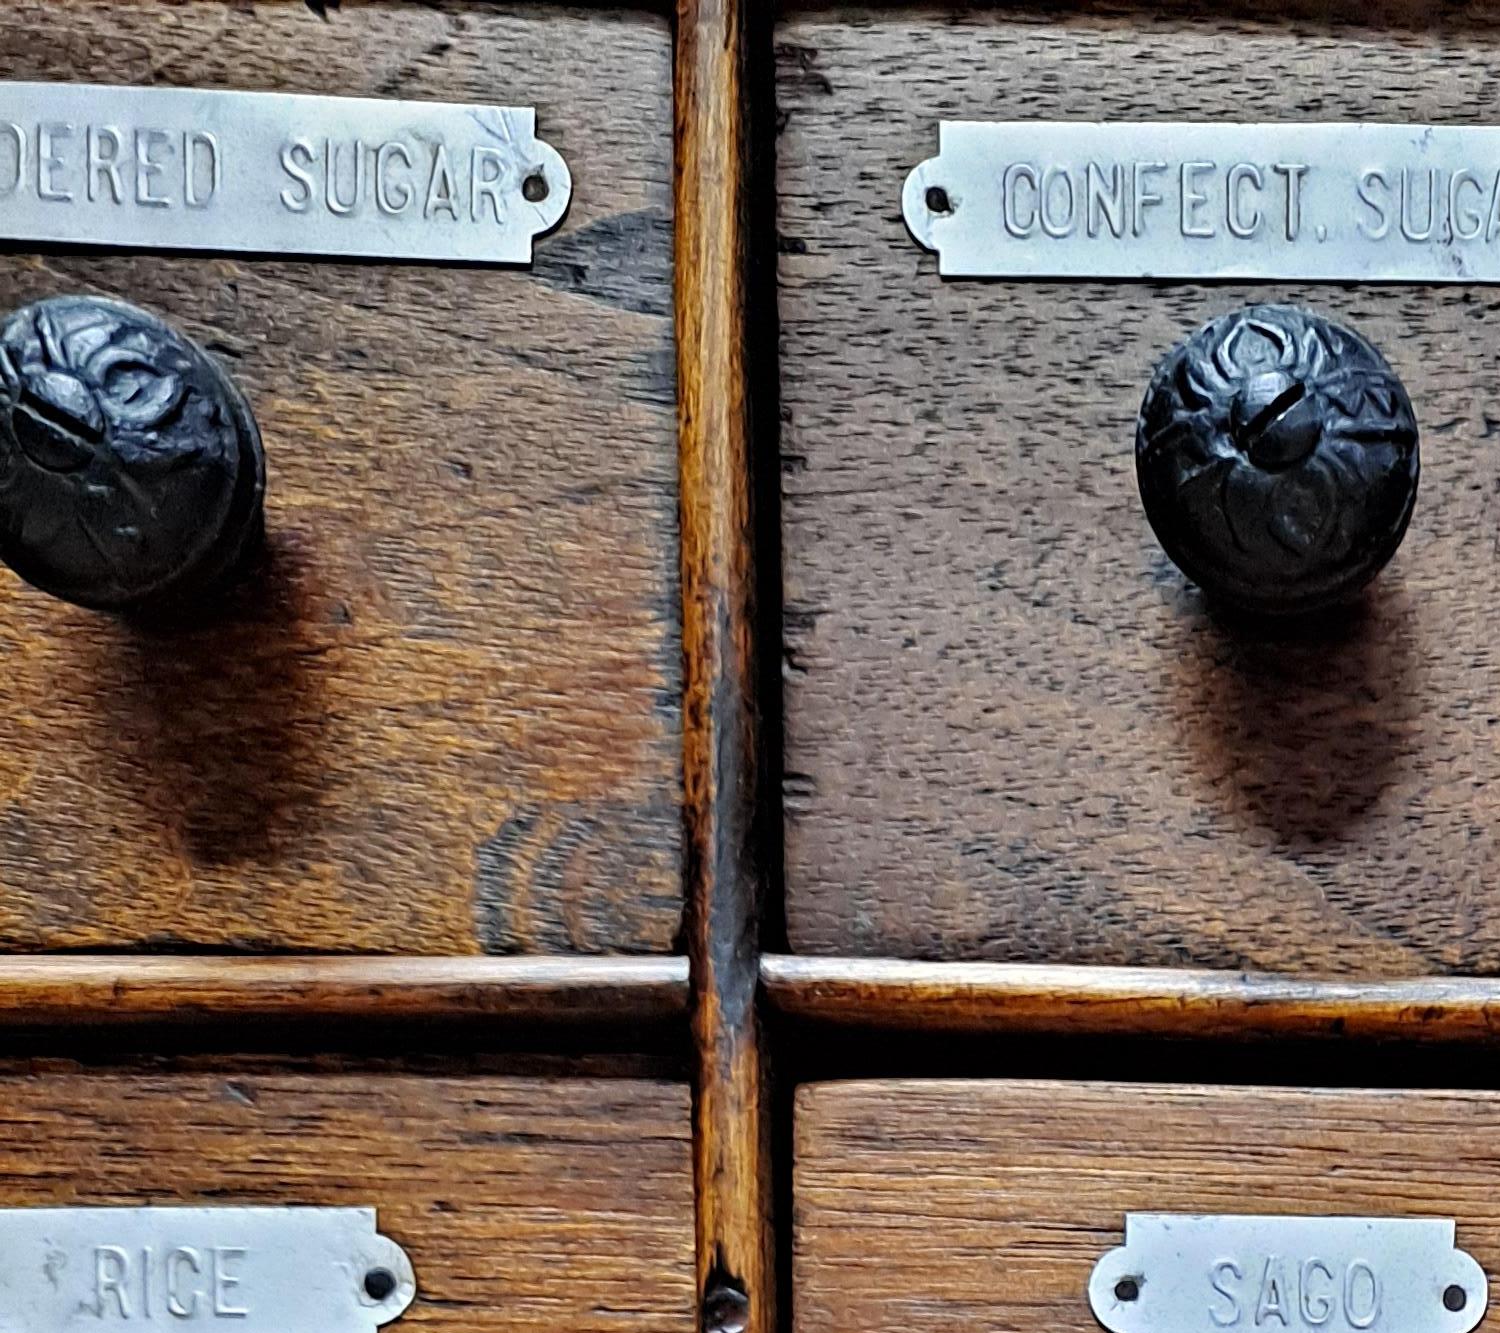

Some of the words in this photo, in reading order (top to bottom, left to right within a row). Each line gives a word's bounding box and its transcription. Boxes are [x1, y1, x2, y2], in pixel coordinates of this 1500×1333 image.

[280, 134, 506, 226] SUGAR
[93, 1244, 249, 1320] RICE
[1207, 1255, 1382, 1330] SAGO
